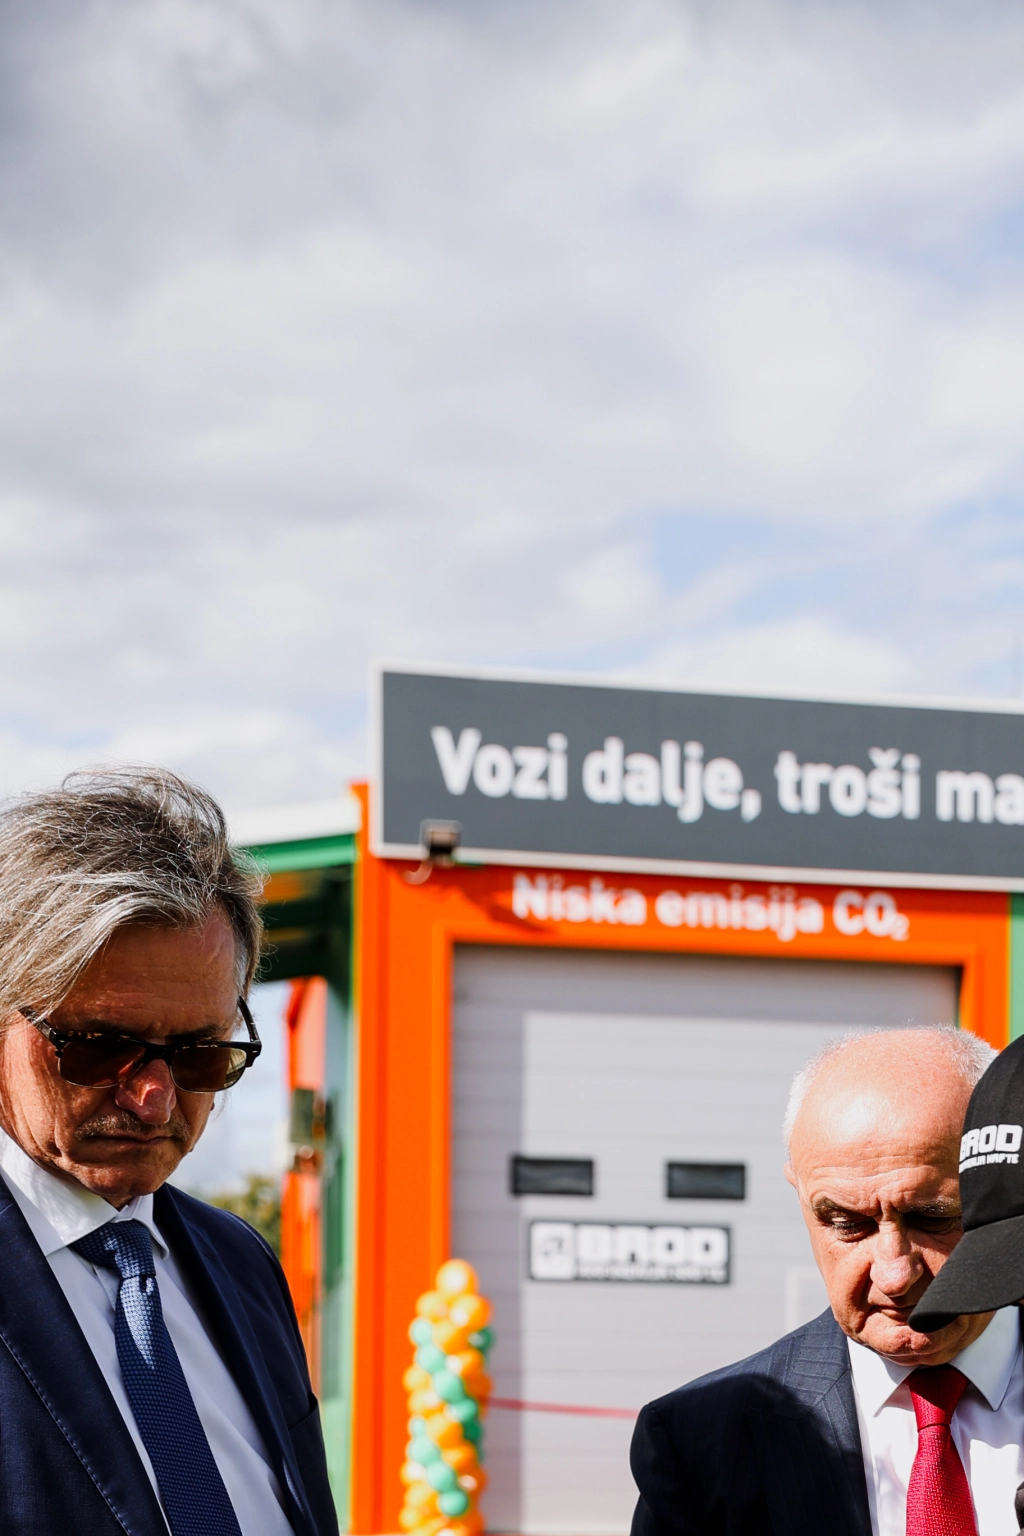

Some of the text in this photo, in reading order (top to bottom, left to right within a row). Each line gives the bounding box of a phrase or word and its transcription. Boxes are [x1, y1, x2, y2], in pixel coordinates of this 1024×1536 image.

[431, 724, 568, 801] Vozi
[582, 736, 762, 823] dalje,
[775, 746, 921, 820] troši
[512, 872, 647, 926] Niska
[655, 883, 825, 942] emisija
